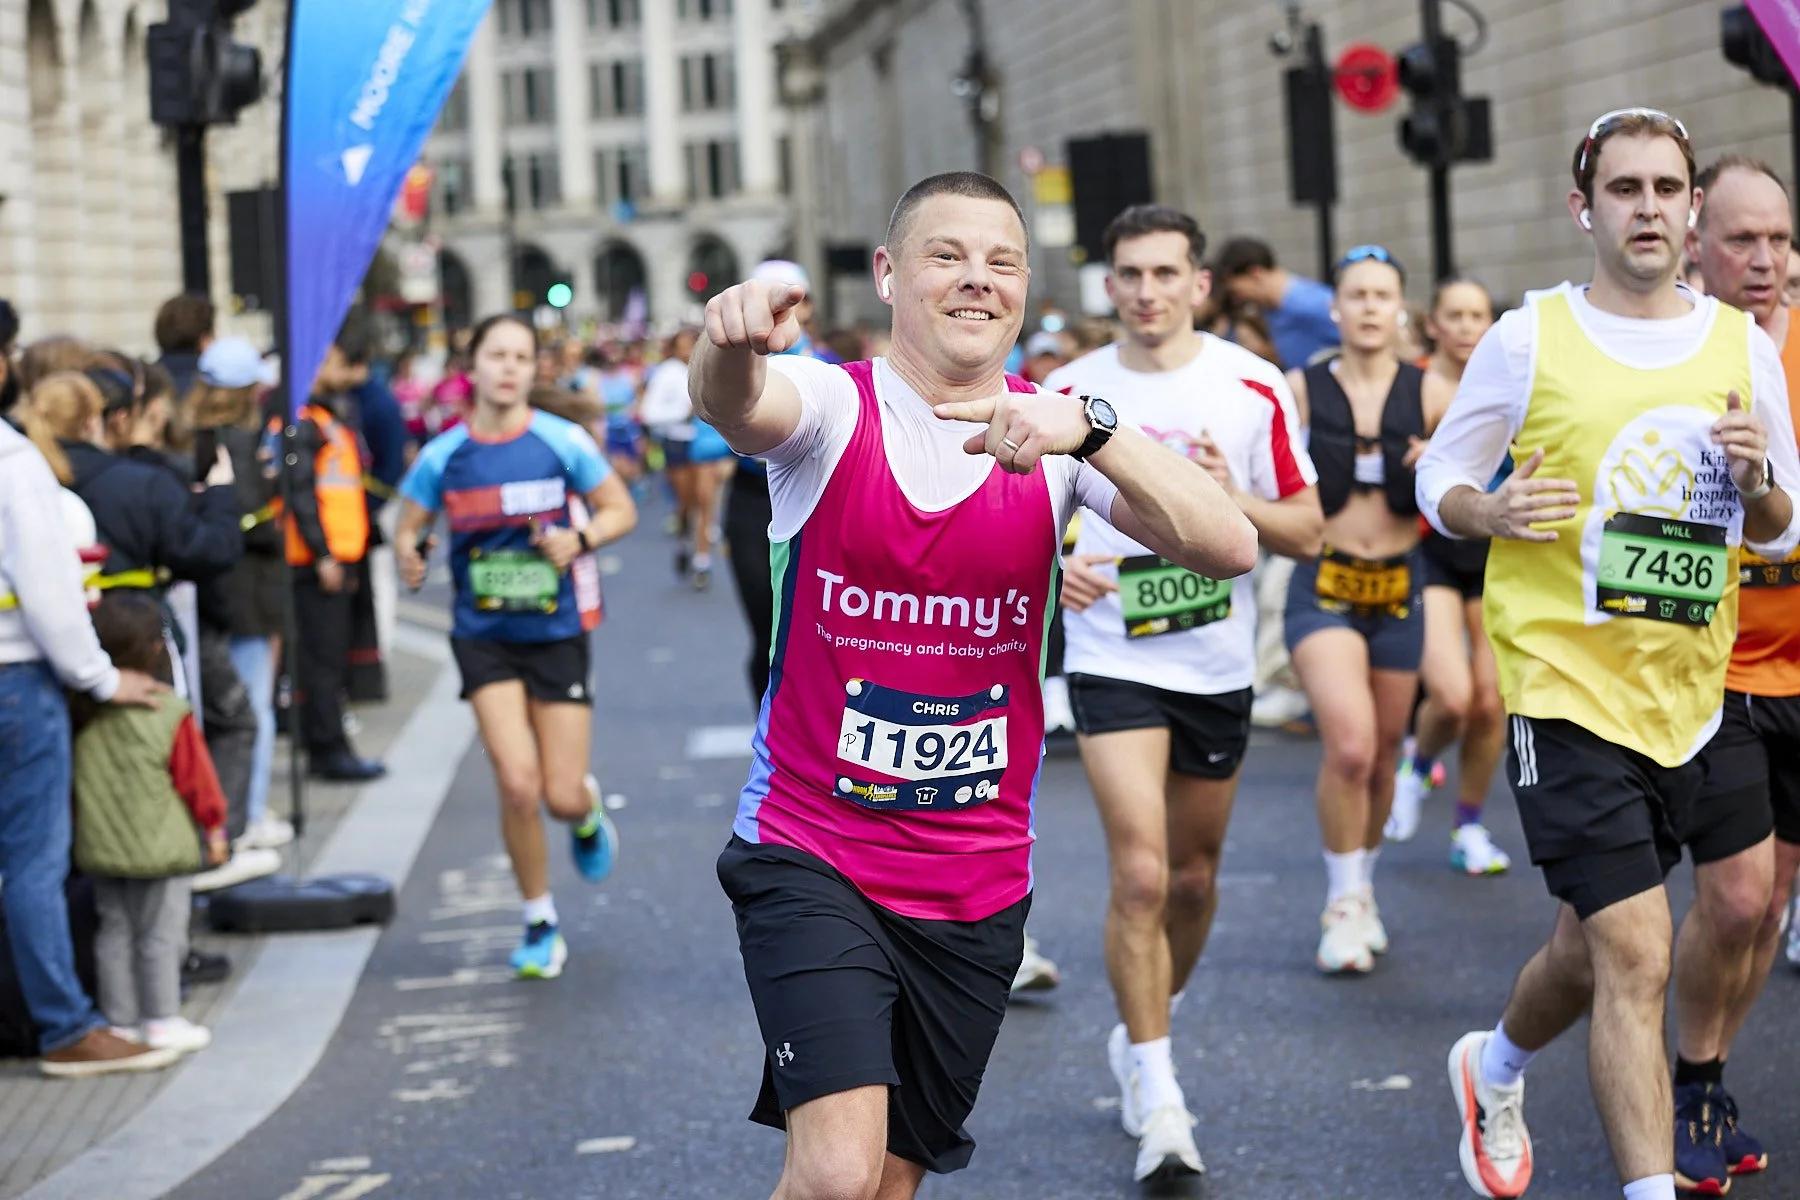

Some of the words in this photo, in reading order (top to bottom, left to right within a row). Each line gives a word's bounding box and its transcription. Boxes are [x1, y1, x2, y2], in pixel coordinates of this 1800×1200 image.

[349, 22, 416, 130] MOORE
[1661, 523, 1692, 539] WILL
[1690, 504, 1737, 522] charity
[1624, 544, 1714, 590] 7436
[816, 568, 1030, 638] Tommy's
[1137, 572, 1218, 608] 8009
[815, 622, 832, 642] The
[835, 634, 912, 656] pregnancy
[916, 642, 944, 655] and
[948, 642, 984, 658] baby
[989, 638, 1027, 656] charity
[912, 701, 960, 716] CHRIS
[856, 720, 998, 771] 11924
